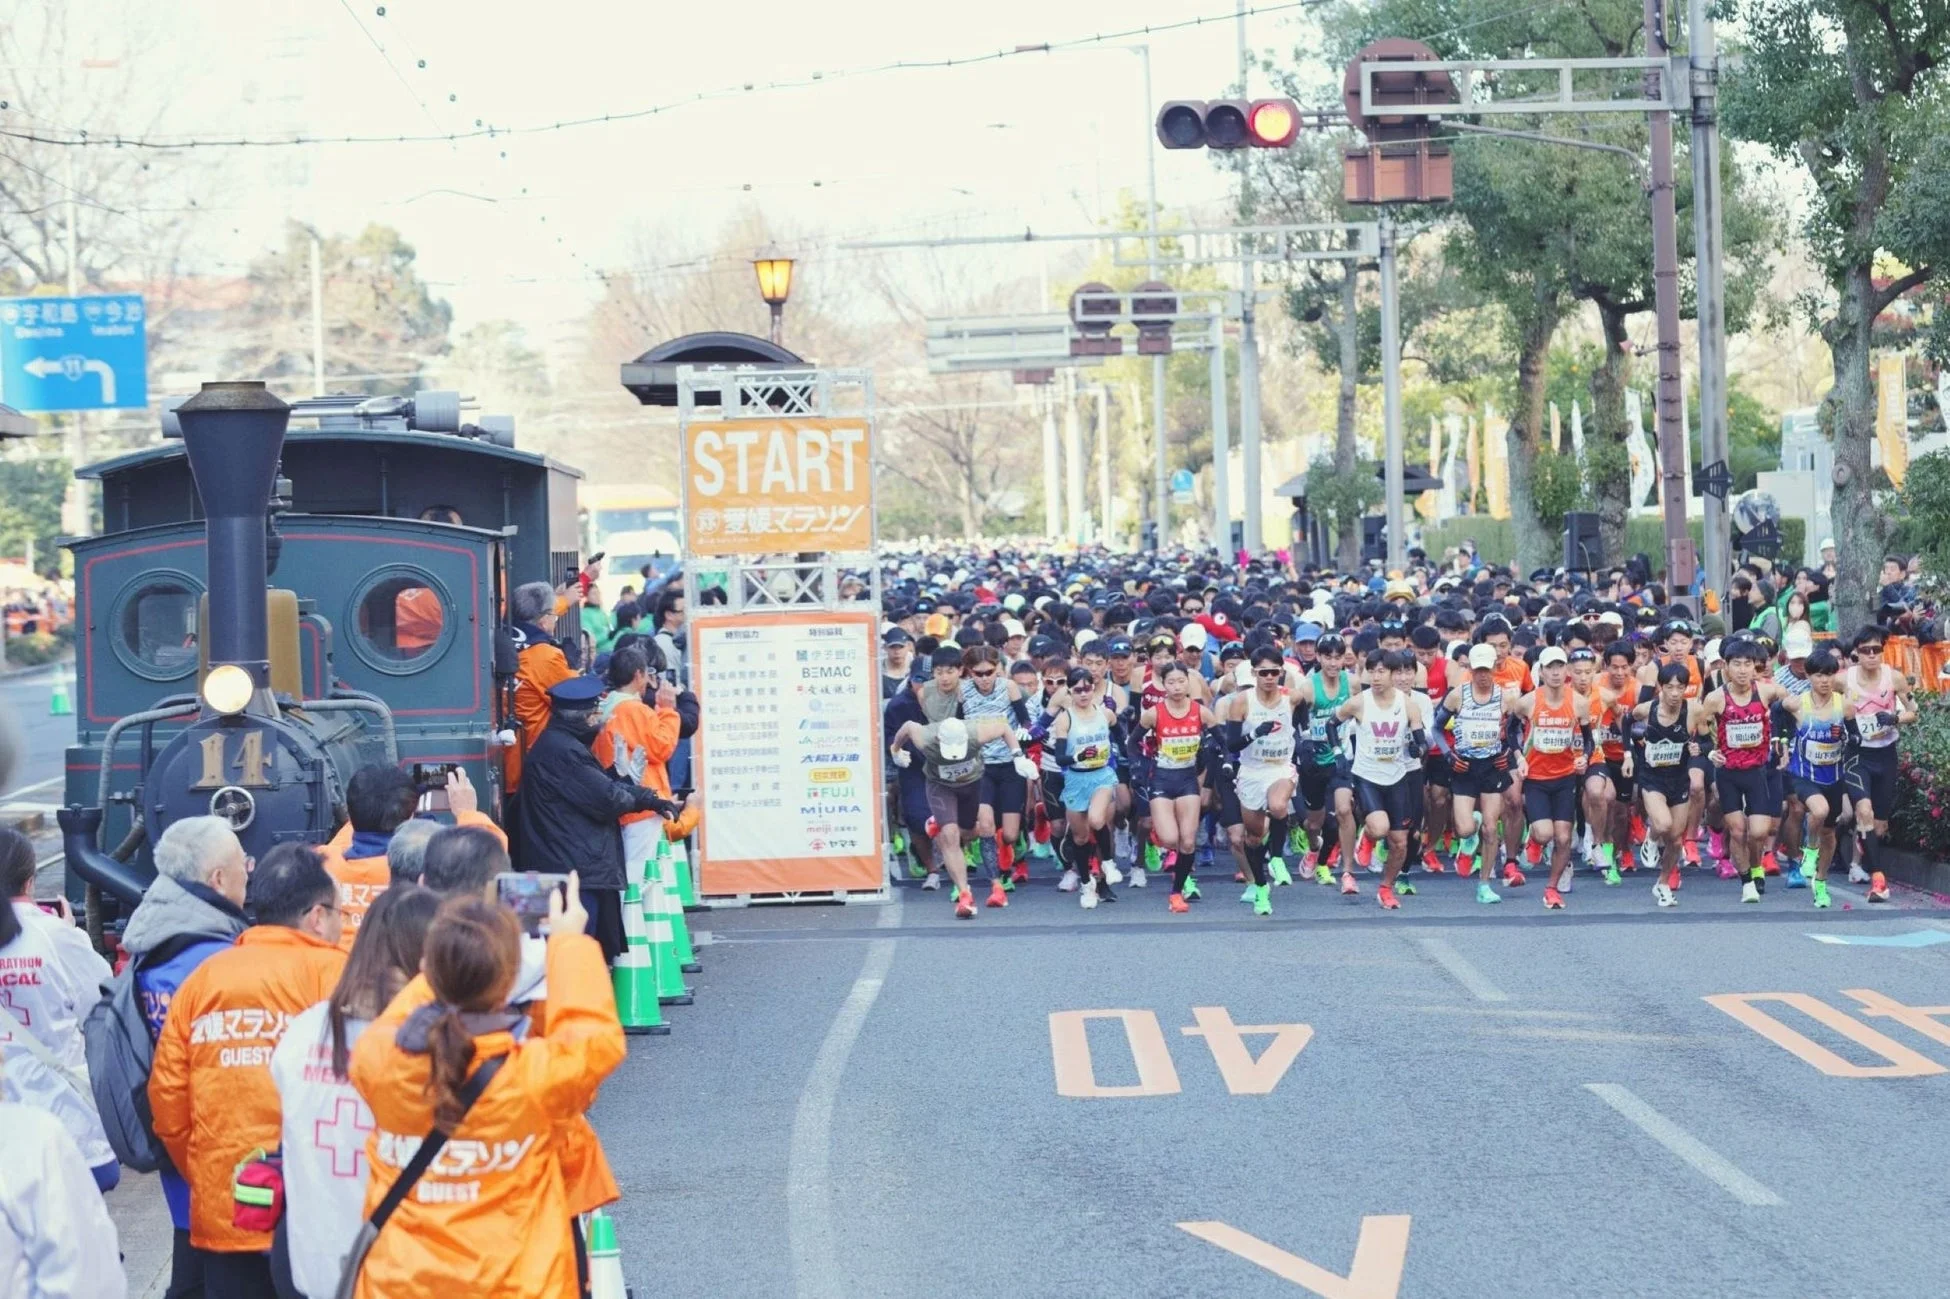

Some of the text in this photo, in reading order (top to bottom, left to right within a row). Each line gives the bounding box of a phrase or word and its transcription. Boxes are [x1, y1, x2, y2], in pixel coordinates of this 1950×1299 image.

[694, 428, 864, 496] START
[193, 730, 273, 788] 14
[821, 787, 856, 798] FUJI
[828, 839, 858, 849] ヤマキ
[219, 1045, 273, 1067] GUEST
[1048, 1006, 1313, 1098] 40
[416, 1180, 481, 1203] GUEST
